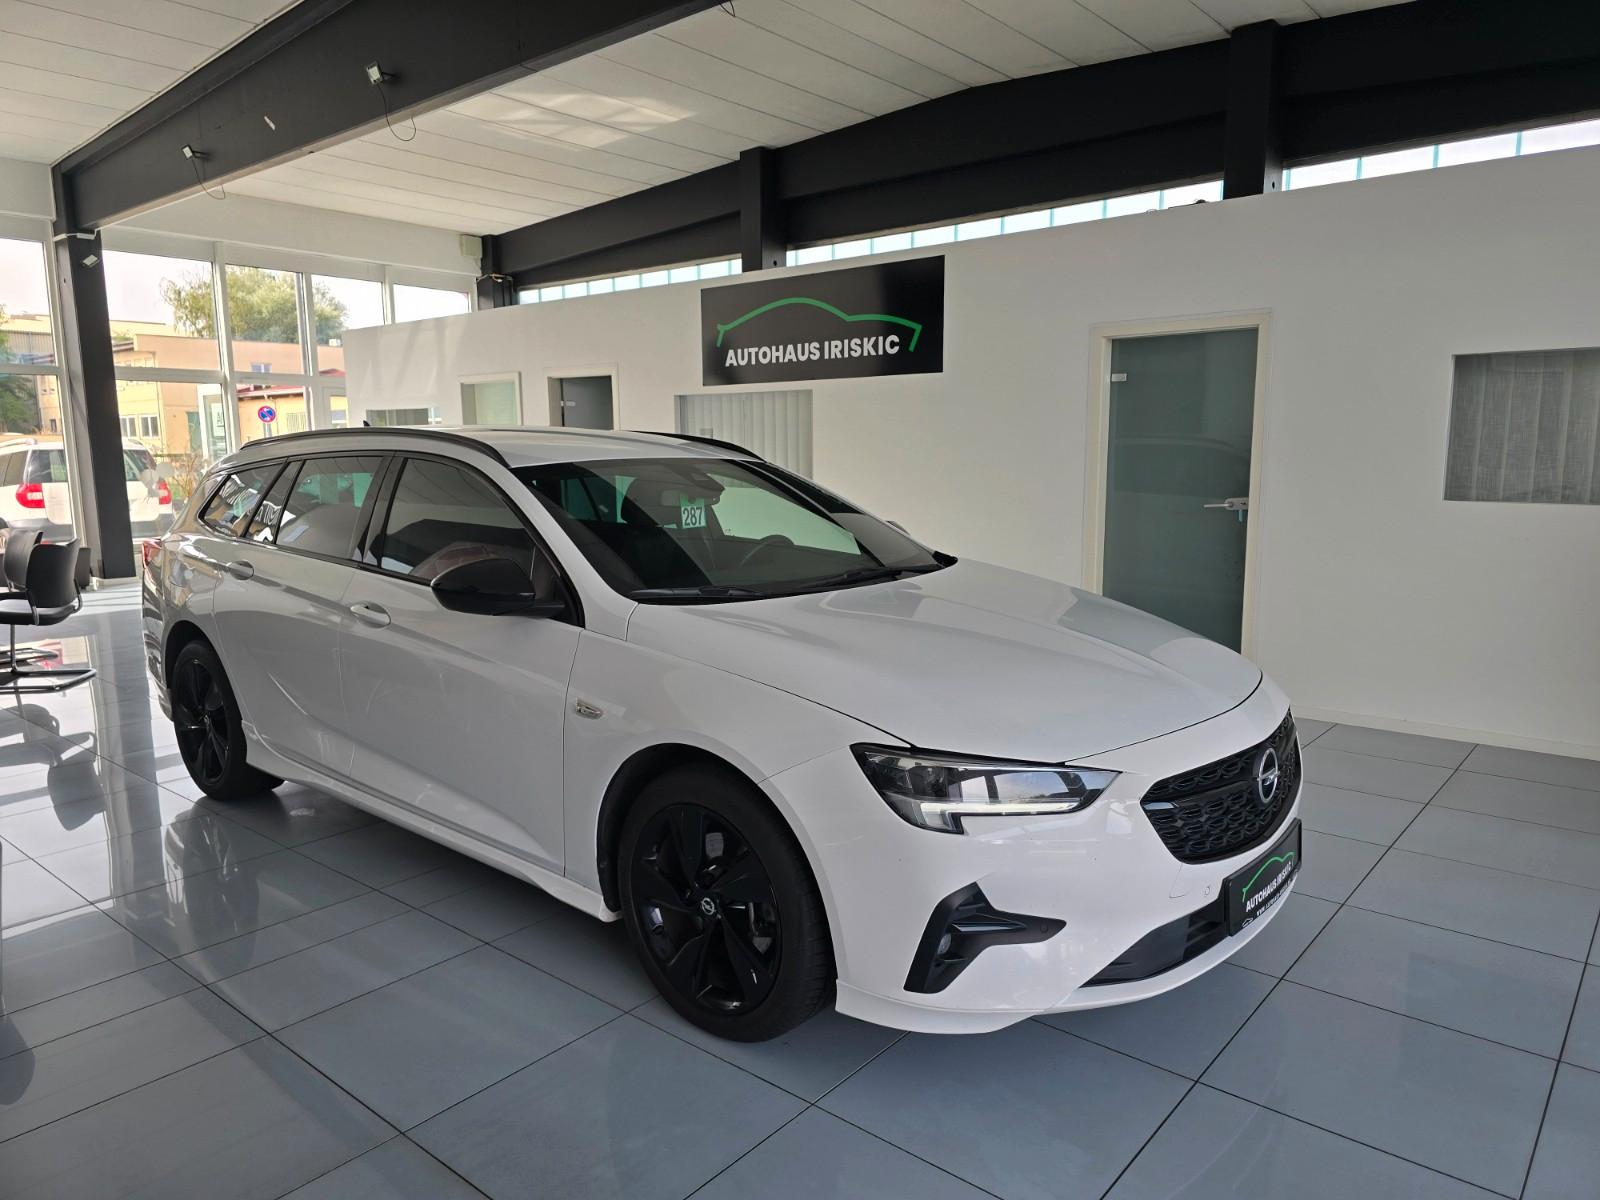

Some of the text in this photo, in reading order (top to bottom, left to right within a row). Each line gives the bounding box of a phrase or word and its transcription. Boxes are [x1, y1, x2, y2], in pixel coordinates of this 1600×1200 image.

[725, 334, 900, 367] AUTOHAUS IRISKIC
[682, 506, 703, 527] 287
[1246, 879, 1277, 912] AUTOHAUS
